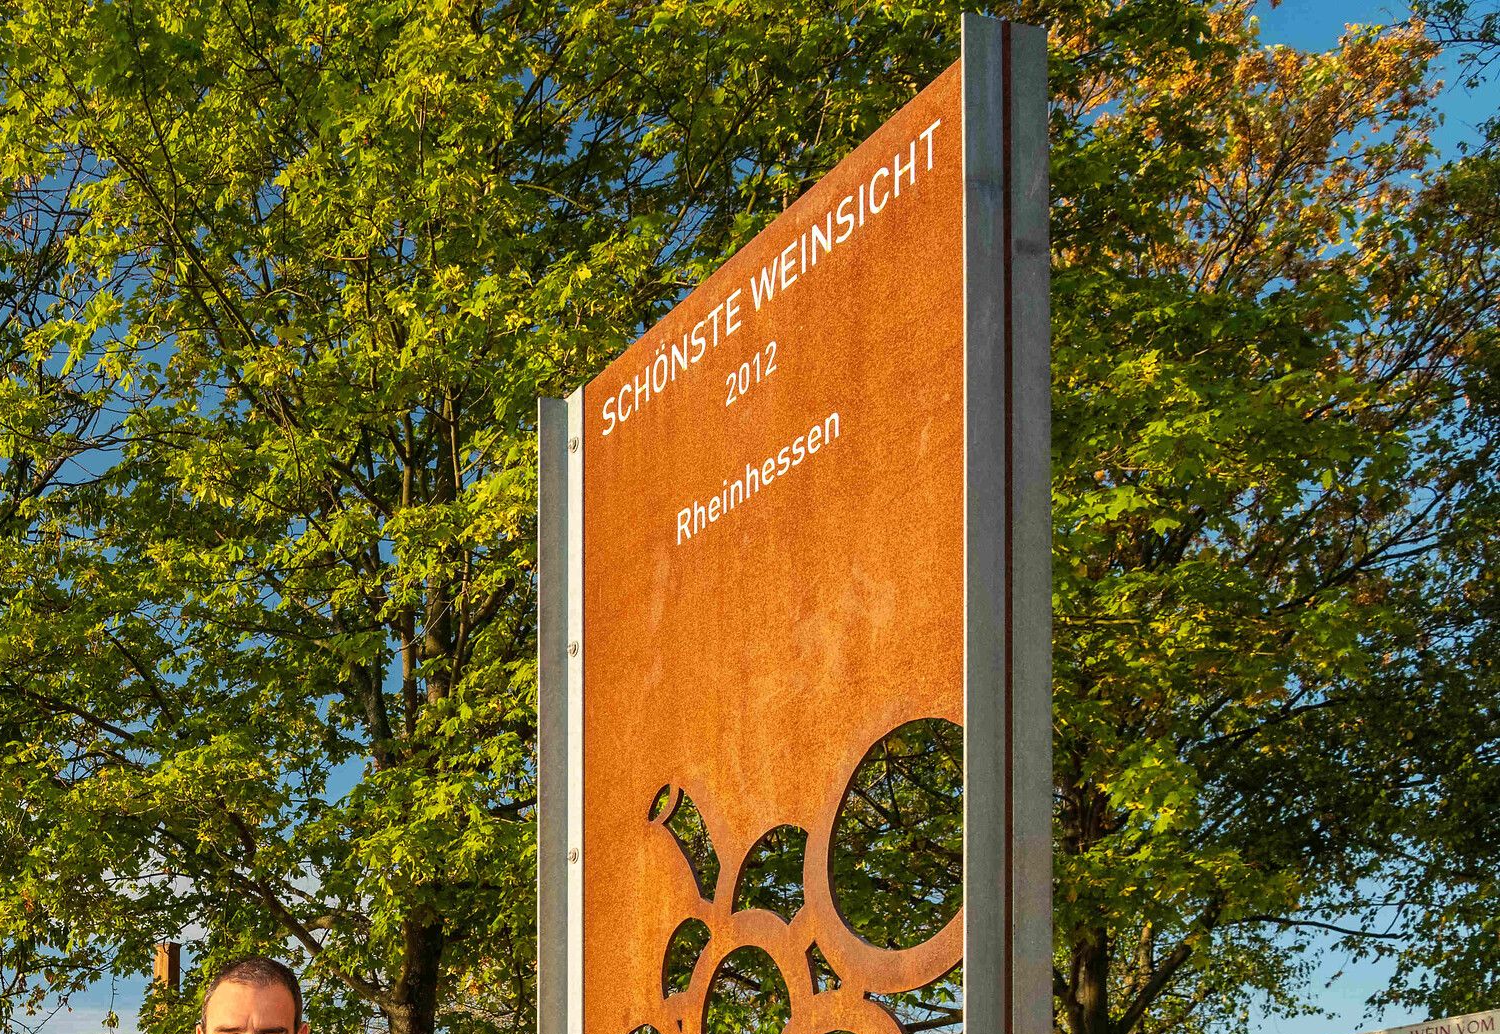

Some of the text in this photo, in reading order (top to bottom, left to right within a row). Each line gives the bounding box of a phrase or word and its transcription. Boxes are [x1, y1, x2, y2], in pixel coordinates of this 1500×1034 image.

[601, 118, 941, 436] SCHÖNSTE WEINSICHT
[725, 341, 777, 407] 2012
[677, 412, 840, 545] Rheinhessen
